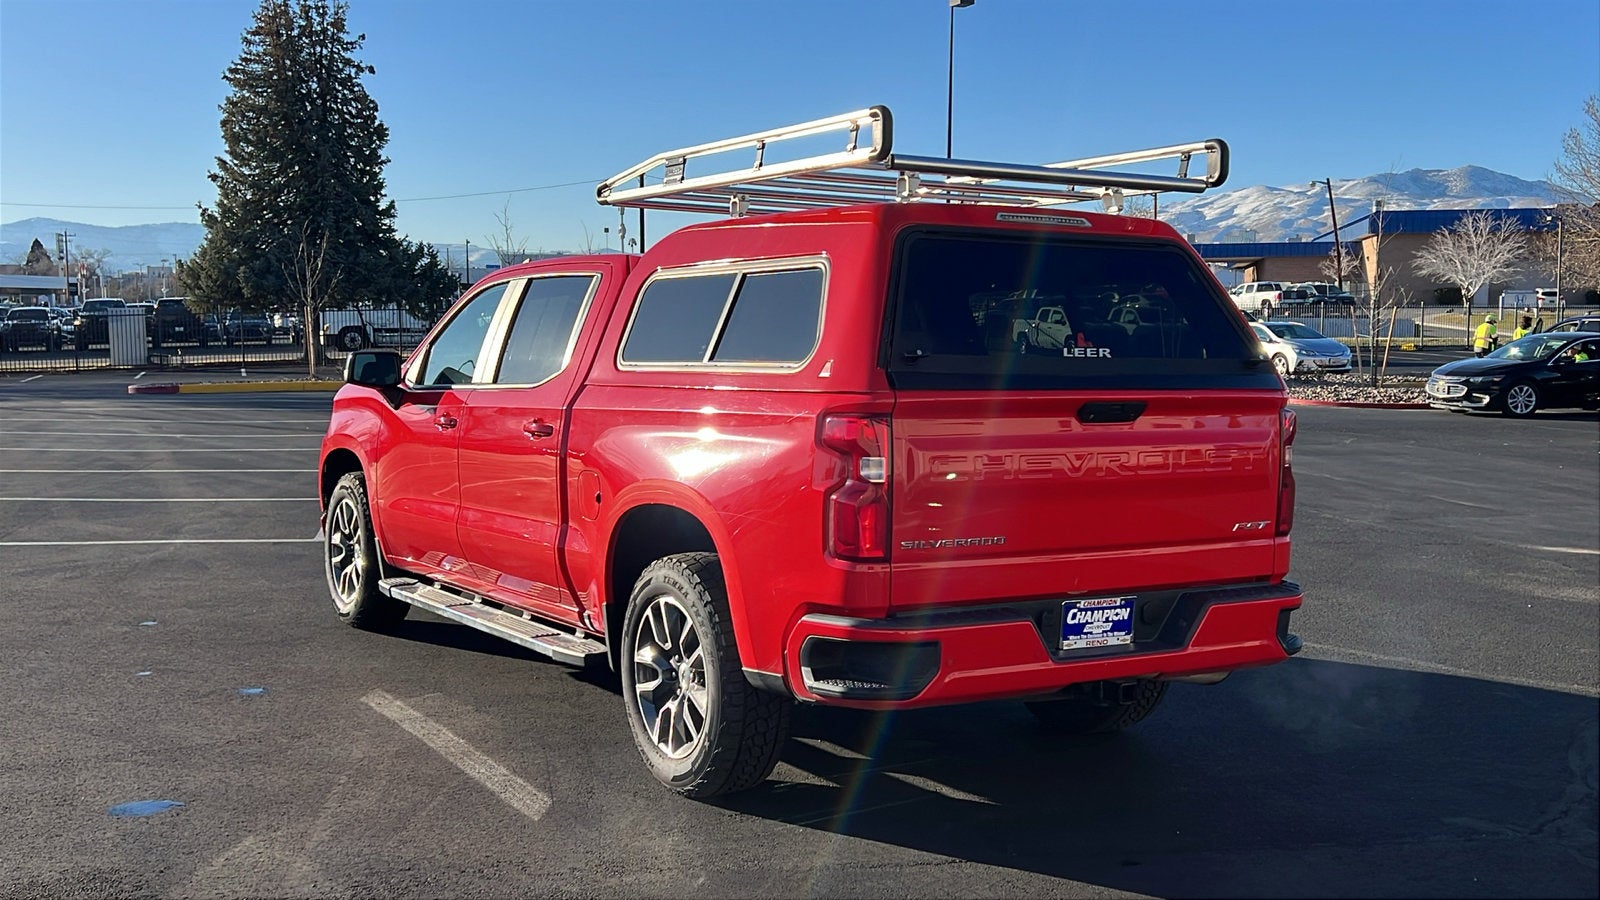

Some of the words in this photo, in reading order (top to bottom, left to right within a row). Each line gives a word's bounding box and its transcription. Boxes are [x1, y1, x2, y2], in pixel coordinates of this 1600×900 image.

[1063, 347, 1112, 358] LEER
[930, 444, 1265, 479] CHEVROLET
[901, 536, 1006, 550] SILVERADO
[1083, 599, 1118, 607] CHAMPION
[1066, 608, 1131, 624] CHAMPION
[1085, 639, 1109, 647] RENO
